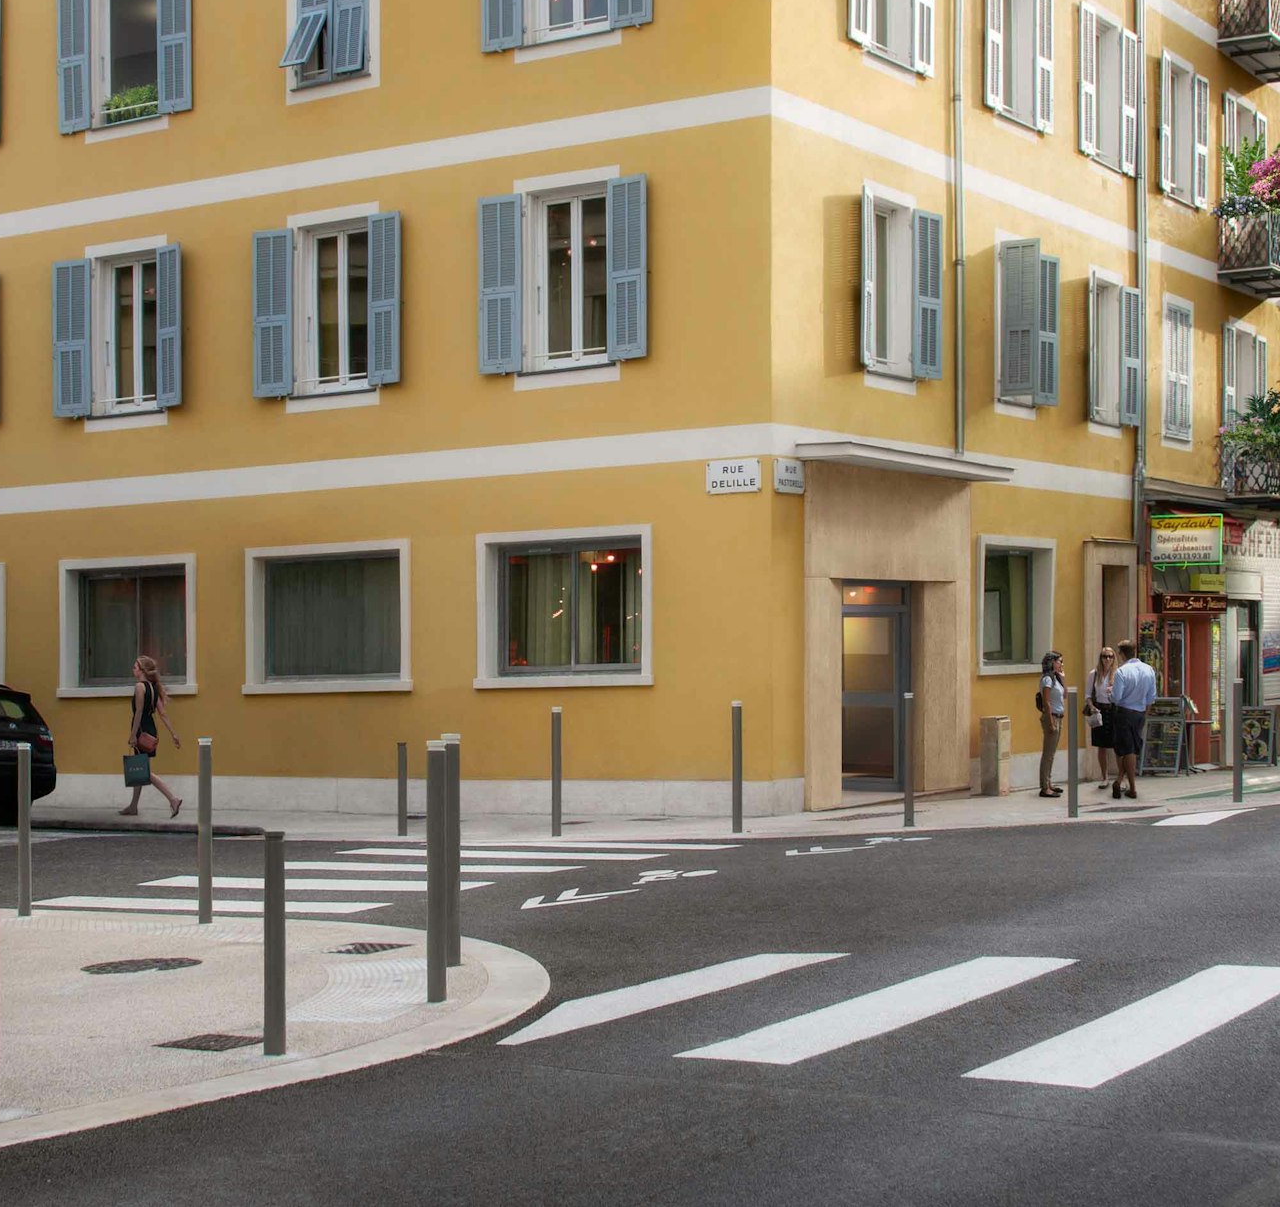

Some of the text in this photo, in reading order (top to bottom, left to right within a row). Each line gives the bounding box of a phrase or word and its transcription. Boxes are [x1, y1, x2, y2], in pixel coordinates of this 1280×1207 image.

[722, 465, 744, 474] RUE
[785, 465, 797, 474] RUE
[711, 478, 756, 488] DELILLE
